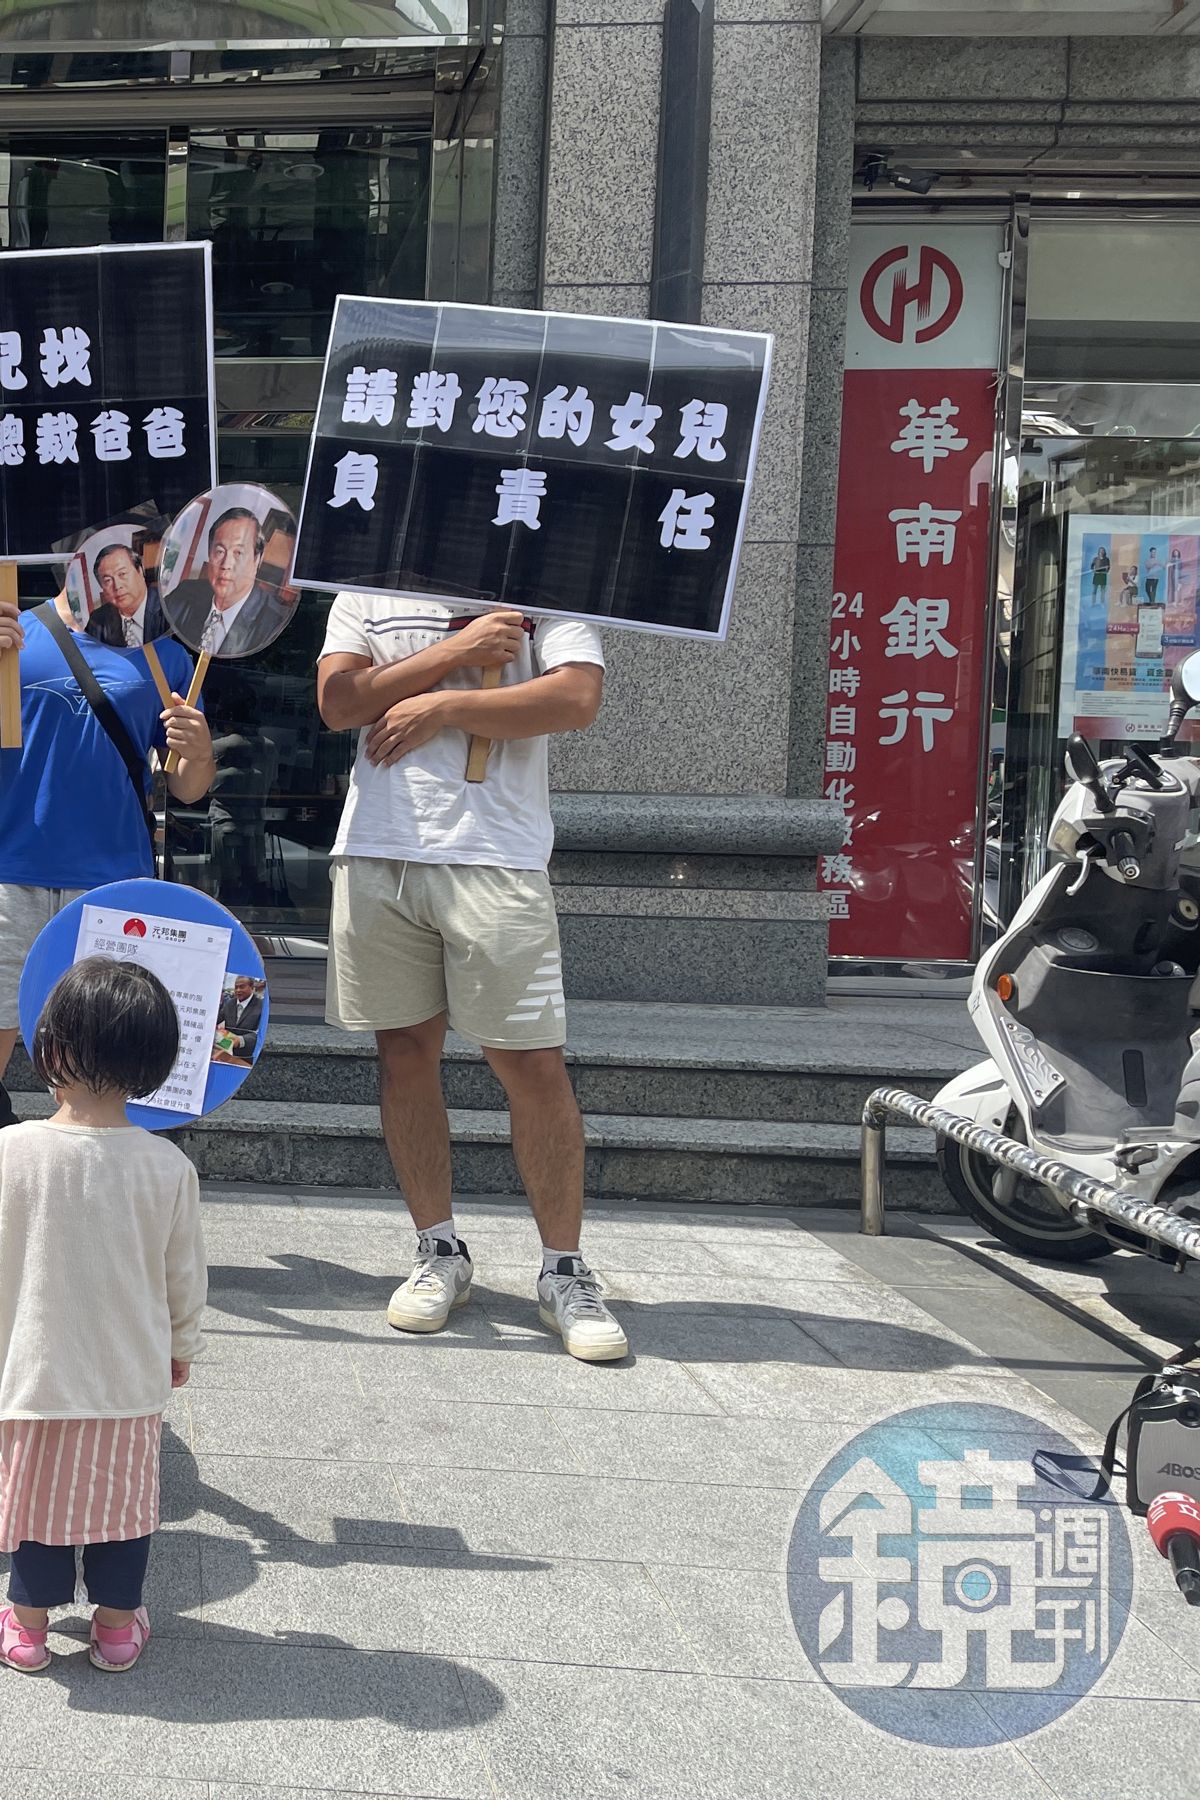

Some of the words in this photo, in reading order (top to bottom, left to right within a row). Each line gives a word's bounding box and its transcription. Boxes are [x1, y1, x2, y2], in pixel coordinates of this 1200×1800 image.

[341, 366, 729, 463] 請對您的女兒
[878, 397, 969, 752] 華南銀行
[94, 938, 138, 955] 經營團隊
[152, 926, 187, 938] 元邦集團
